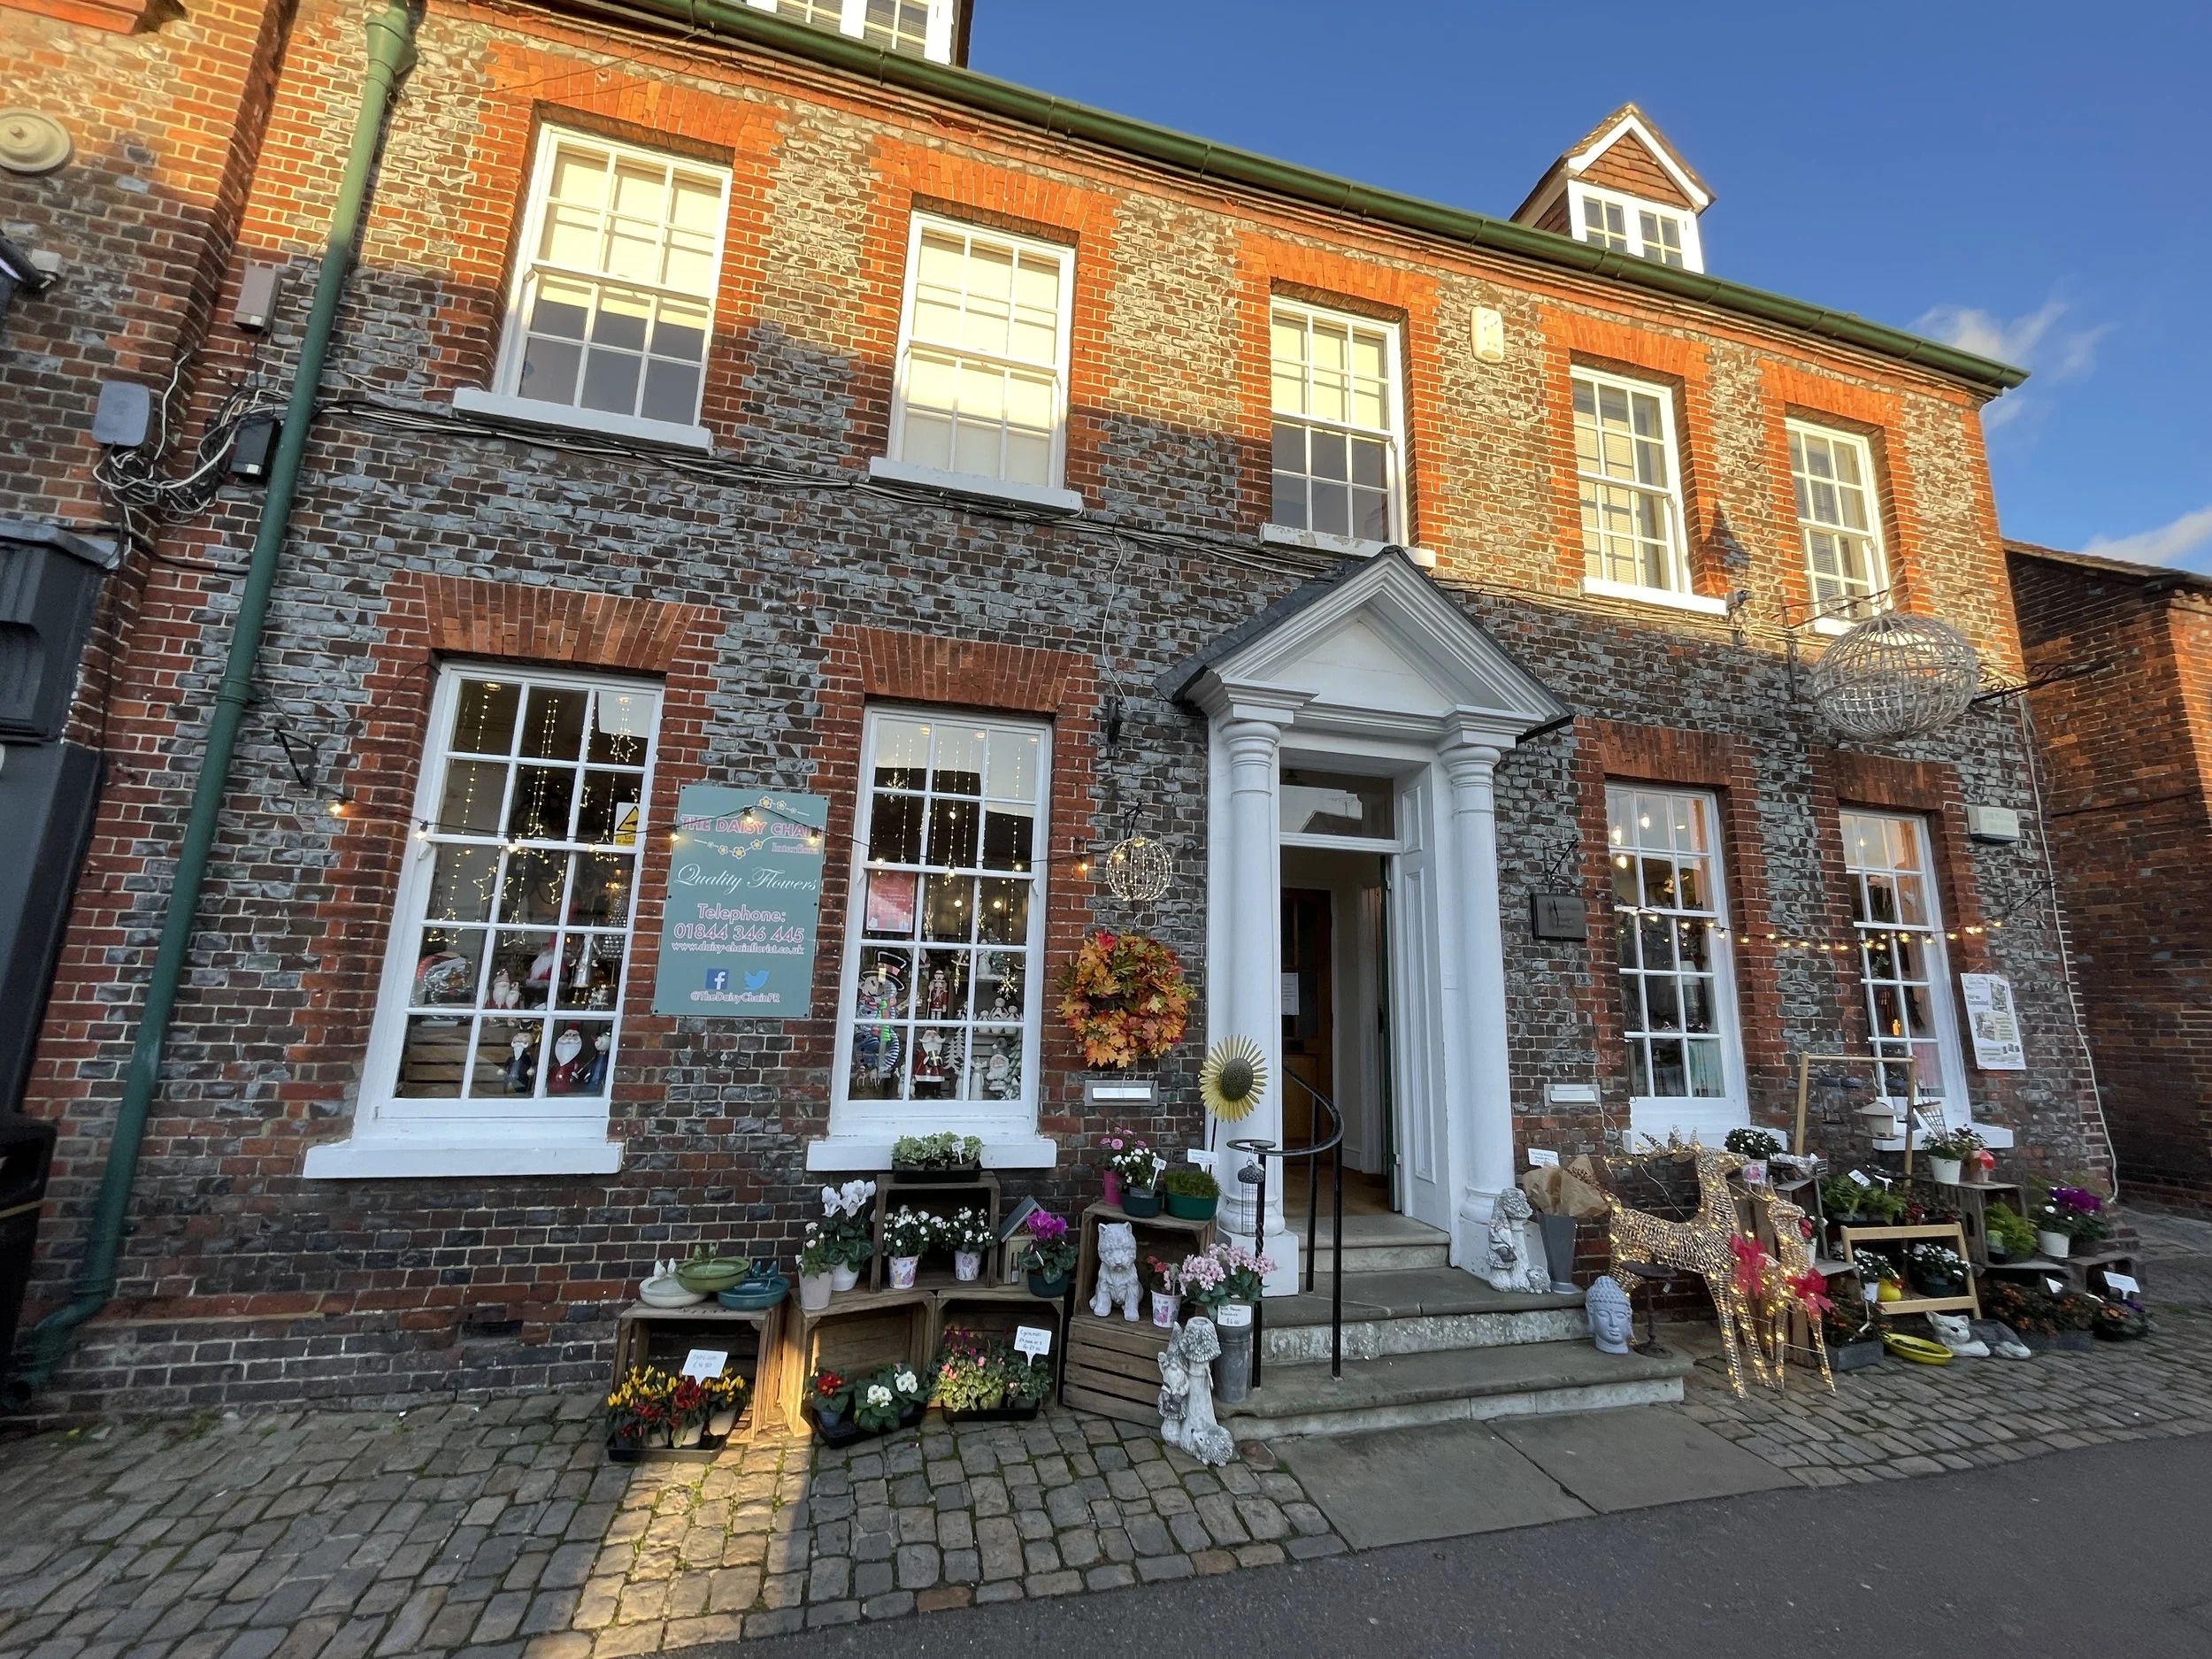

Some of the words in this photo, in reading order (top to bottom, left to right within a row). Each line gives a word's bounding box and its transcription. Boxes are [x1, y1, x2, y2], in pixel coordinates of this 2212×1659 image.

[680, 816, 710, 831] THE
[716, 819, 767, 834] DAISY
[673, 863, 742, 895] Quality
[747, 866, 818, 891] Flowers
[697, 902, 787, 925] Telephone:
[673, 923, 728, 940] 01844
[733, 925, 766, 942] 346
[770, 926, 805, 944] 445
[690, 990, 780, 1004] @TheDaisyChainPR
